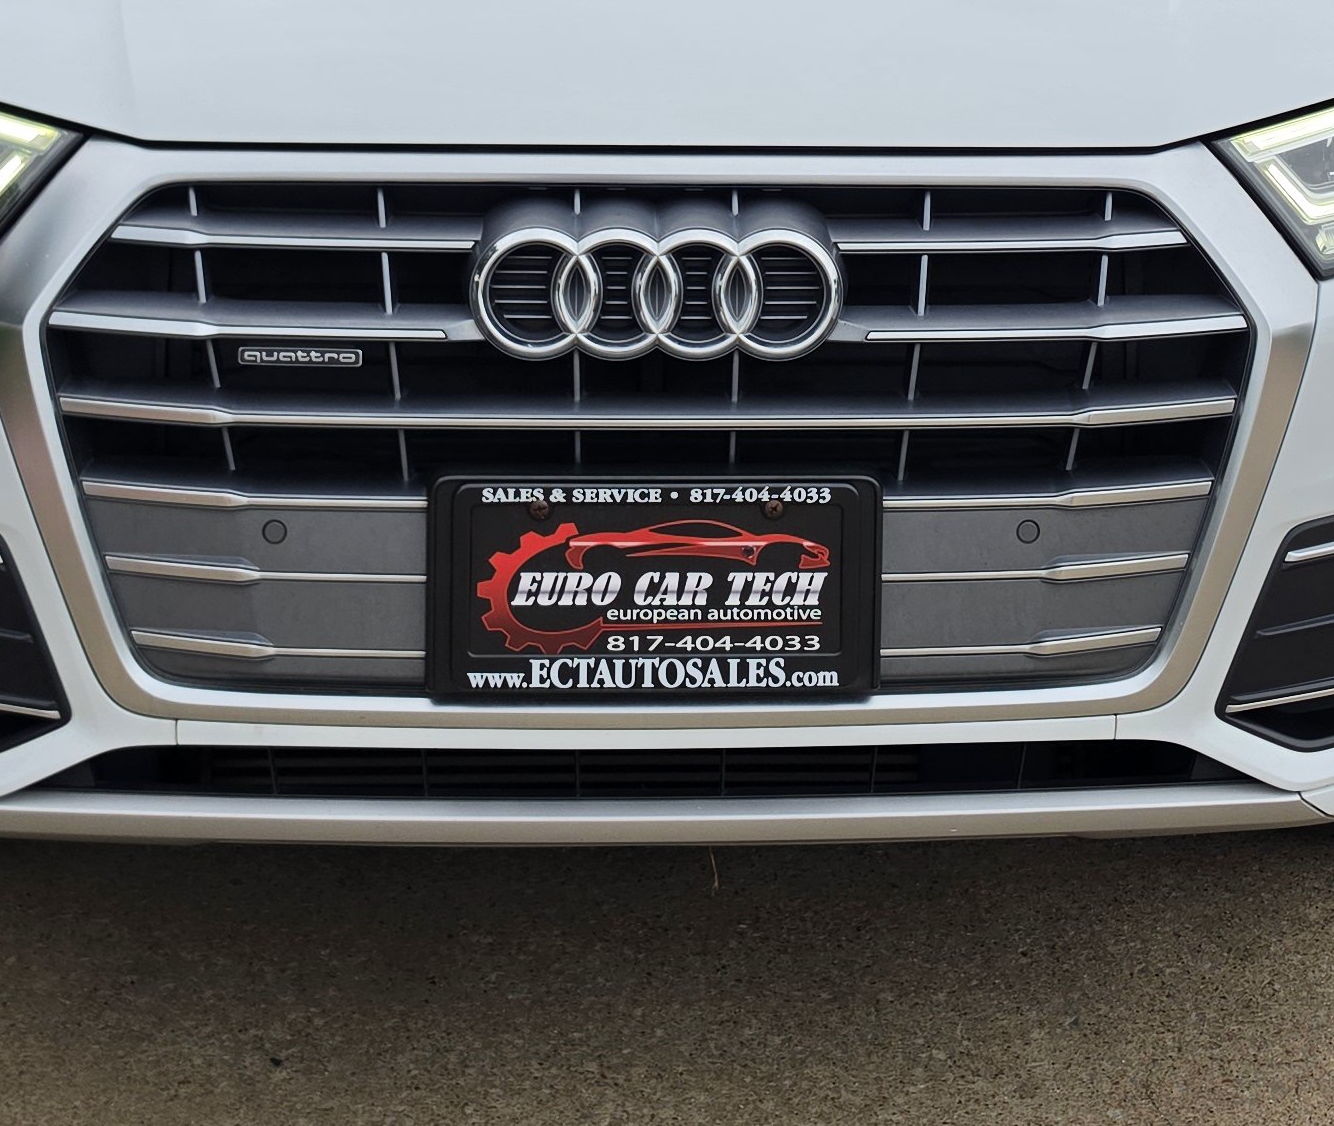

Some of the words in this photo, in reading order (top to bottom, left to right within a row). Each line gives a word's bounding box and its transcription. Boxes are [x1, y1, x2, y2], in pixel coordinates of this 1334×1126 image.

[244, 350, 355, 362] quattro
[482, 488, 544, 503] SALES
[549, 488, 566, 503] &
[572, 488, 662, 503] SERVICE
[689, 486, 831, 503] 817-404-4033
[511, 571, 622, 606] EURO
[633, 571, 713, 606] CAR
[724, 571, 828, 606] TECH
[606, 608, 702, 623] european
[707, 606, 822, 620] automotive
[606, 635, 821, 651] 817-404-4033
[467, 657, 839, 689] www.ECTAUTOSALES.com
